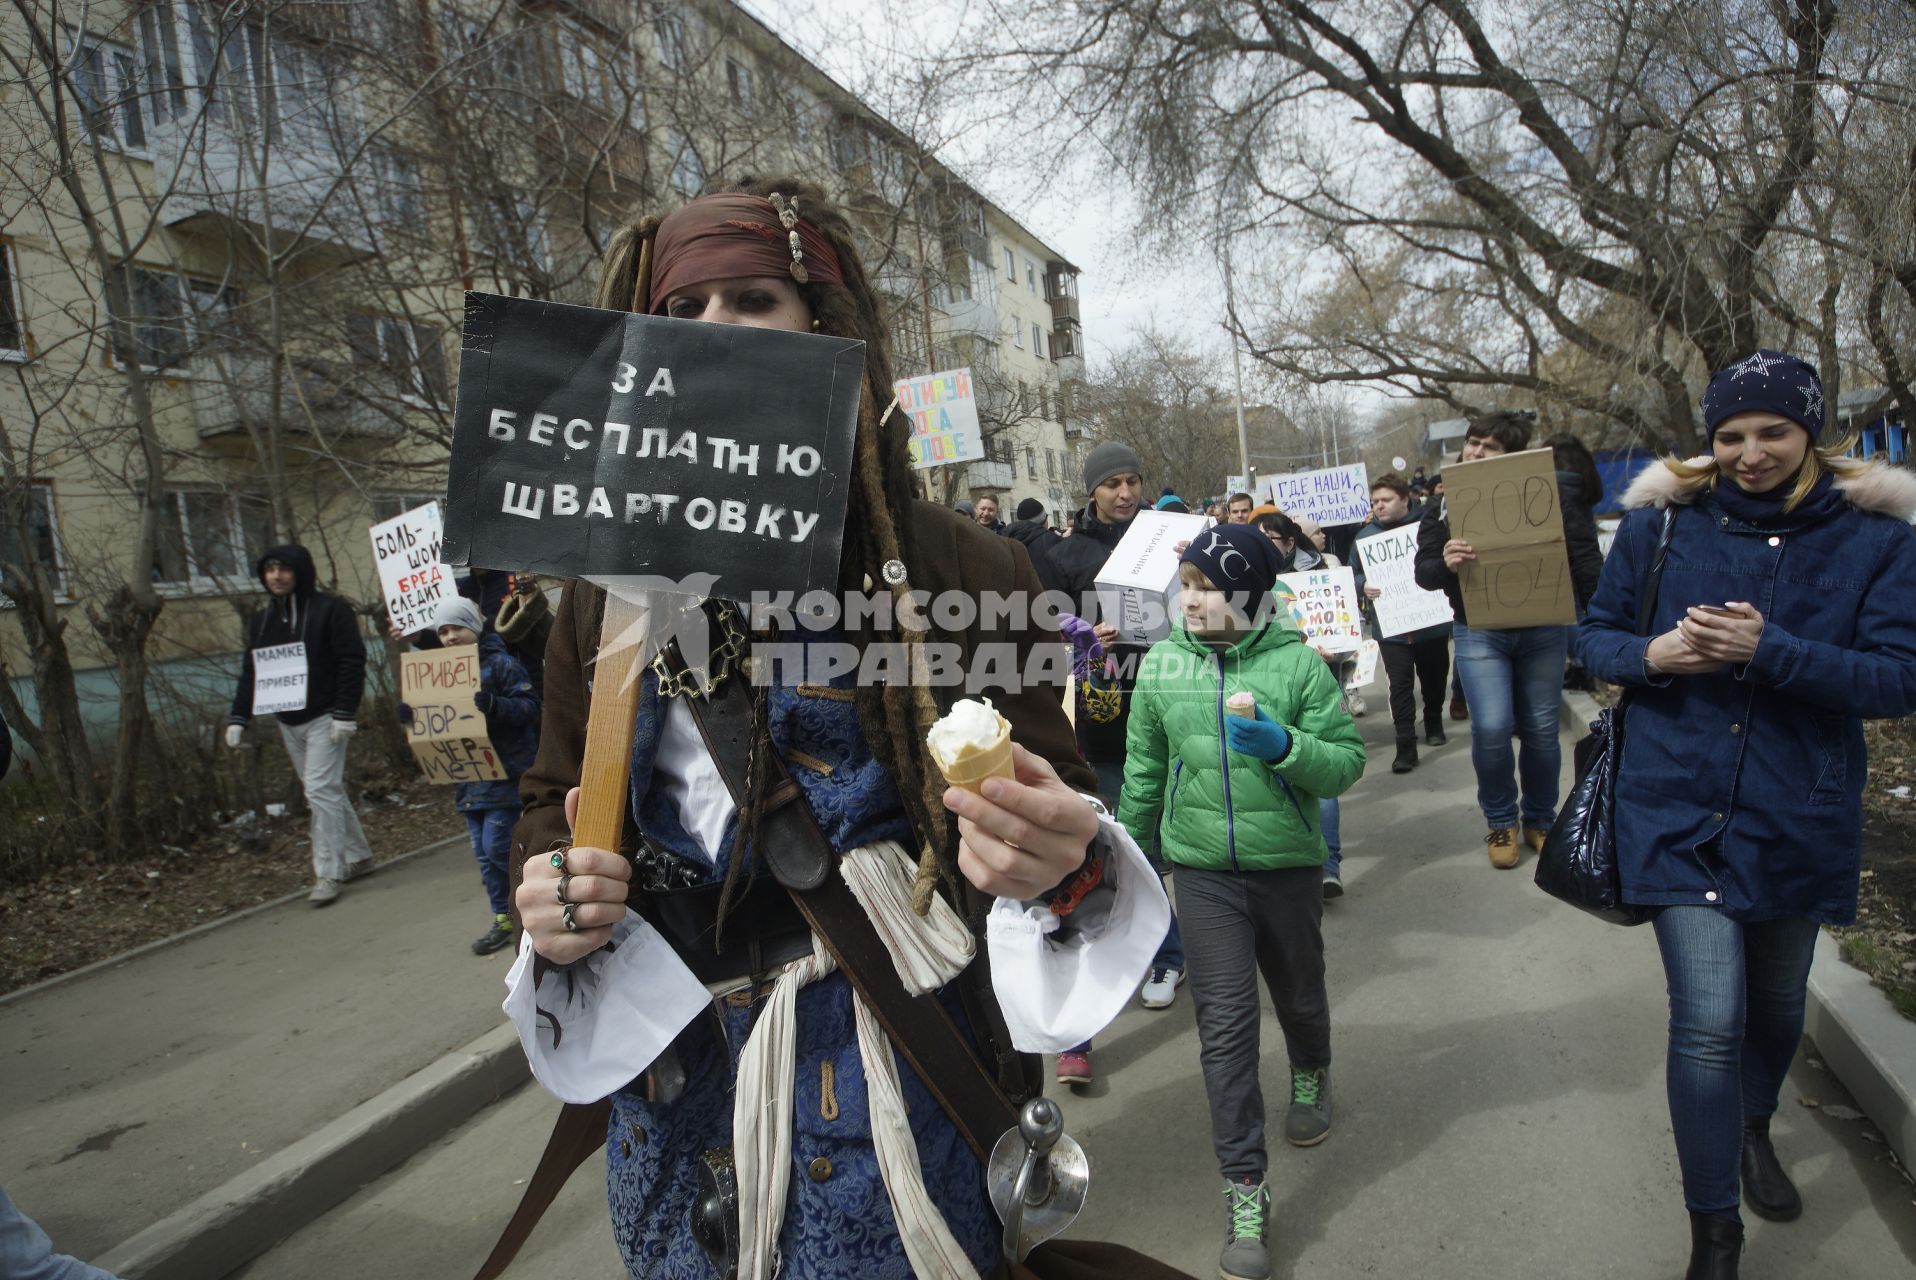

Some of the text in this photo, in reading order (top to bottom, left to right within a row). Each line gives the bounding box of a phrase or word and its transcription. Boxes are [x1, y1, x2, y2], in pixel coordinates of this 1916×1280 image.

[610, 361, 677, 399] ЗА
[894, 371, 971, 410] ОТИРУЙ
[1278, 477, 1309, 498] ГДЕ
[1314, 471, 1352, 493] НАШИ
[501, 481, 820, 543] ШВАРТОВКУ
[1281, 492, 1350, 512] ЗАПЯТЫЕ
[407, 531, 442, 569] ШОЙ
[1363, 533, 1418, 566] КОГДА
[398, 566, 443, 593] БРЕД
[1299, 585, 1342, 600] ОСКОР
[1309, 575, 1330, 585] НЕ
[1464, 557, 1564, 612] 404
[390, 582, 442, 615] СЛЕДИТ
[396, 603, 440, 632] ЗА ТО
[1309, 609, 1350, 625] МОЮ
[1306, 624, 1360, 638] ВЛАСТЬ
[256, 644, 305, 662] МАМКЕ
[257, 674, 306, 691] ПРИВЕТ
